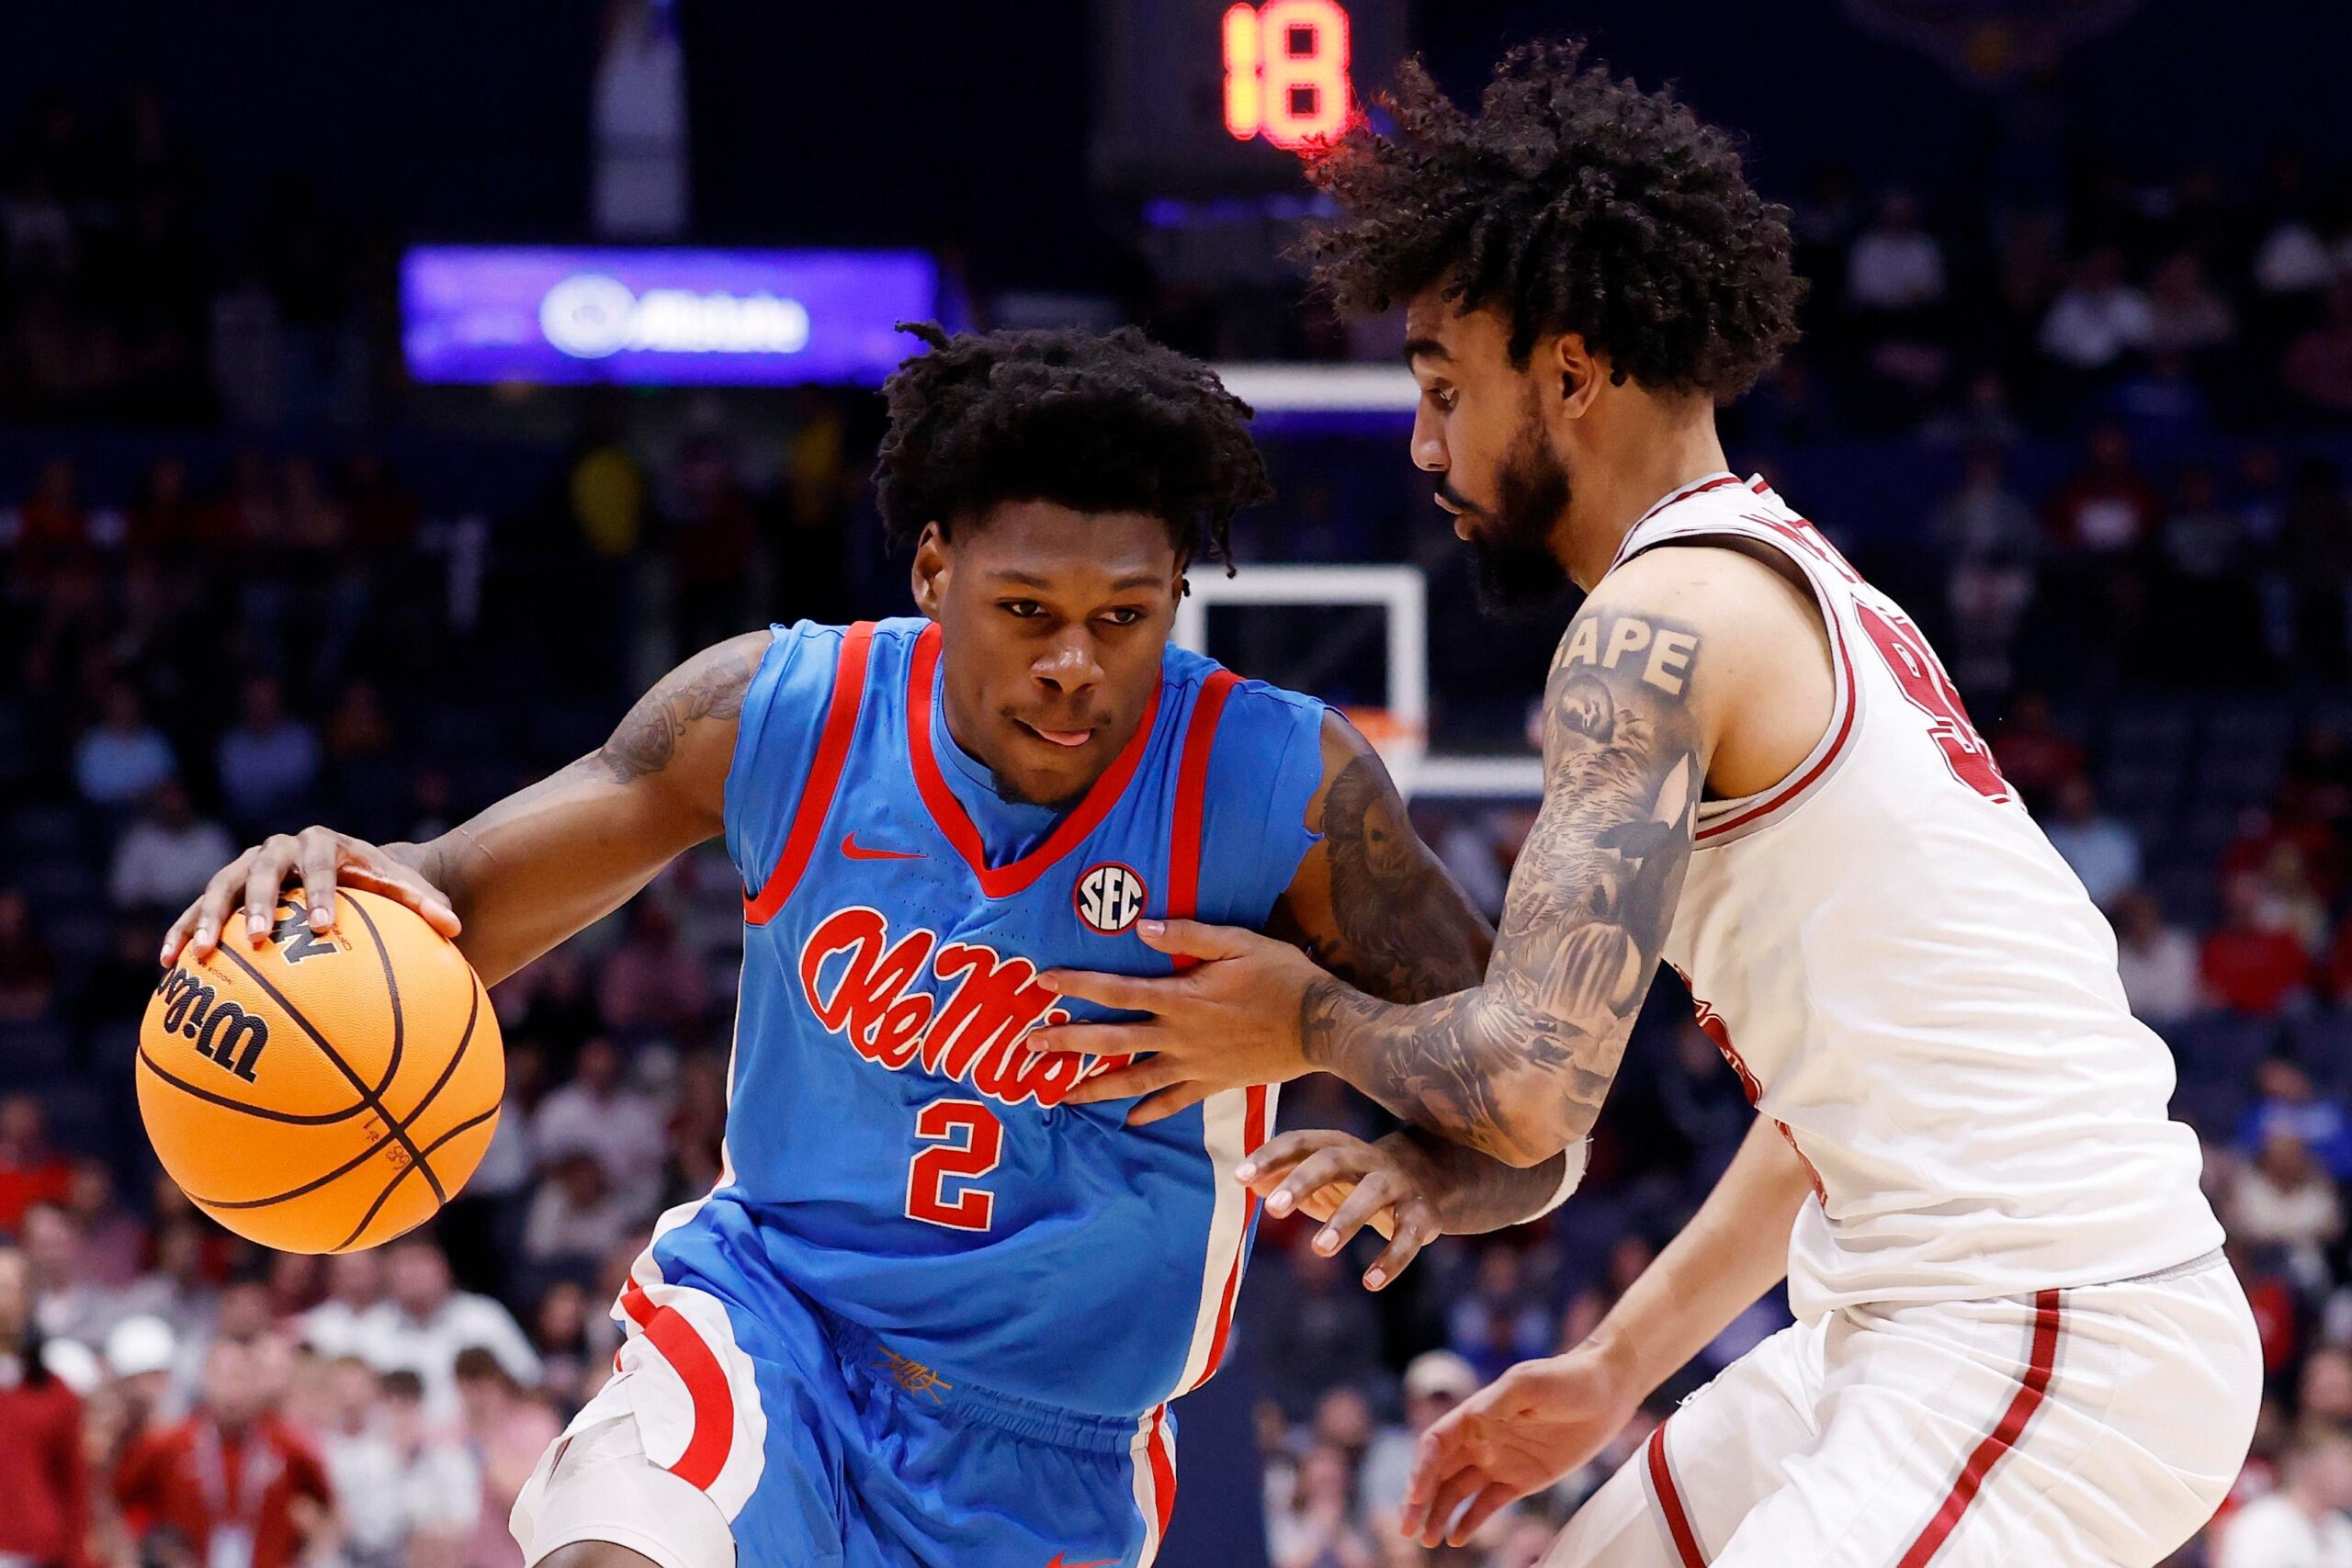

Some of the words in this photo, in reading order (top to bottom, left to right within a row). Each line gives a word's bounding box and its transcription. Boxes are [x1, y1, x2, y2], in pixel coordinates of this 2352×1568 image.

[1223, 0, 1352, 150] 18
[1547, 615, 1699, 695] APE
[1079, 865, 1143, 930] SEC
[157, 965, 269, 1084] Wilso
[798, 905, 936, 1072] Ole
[905, 1099, 1004, 1232] 2
